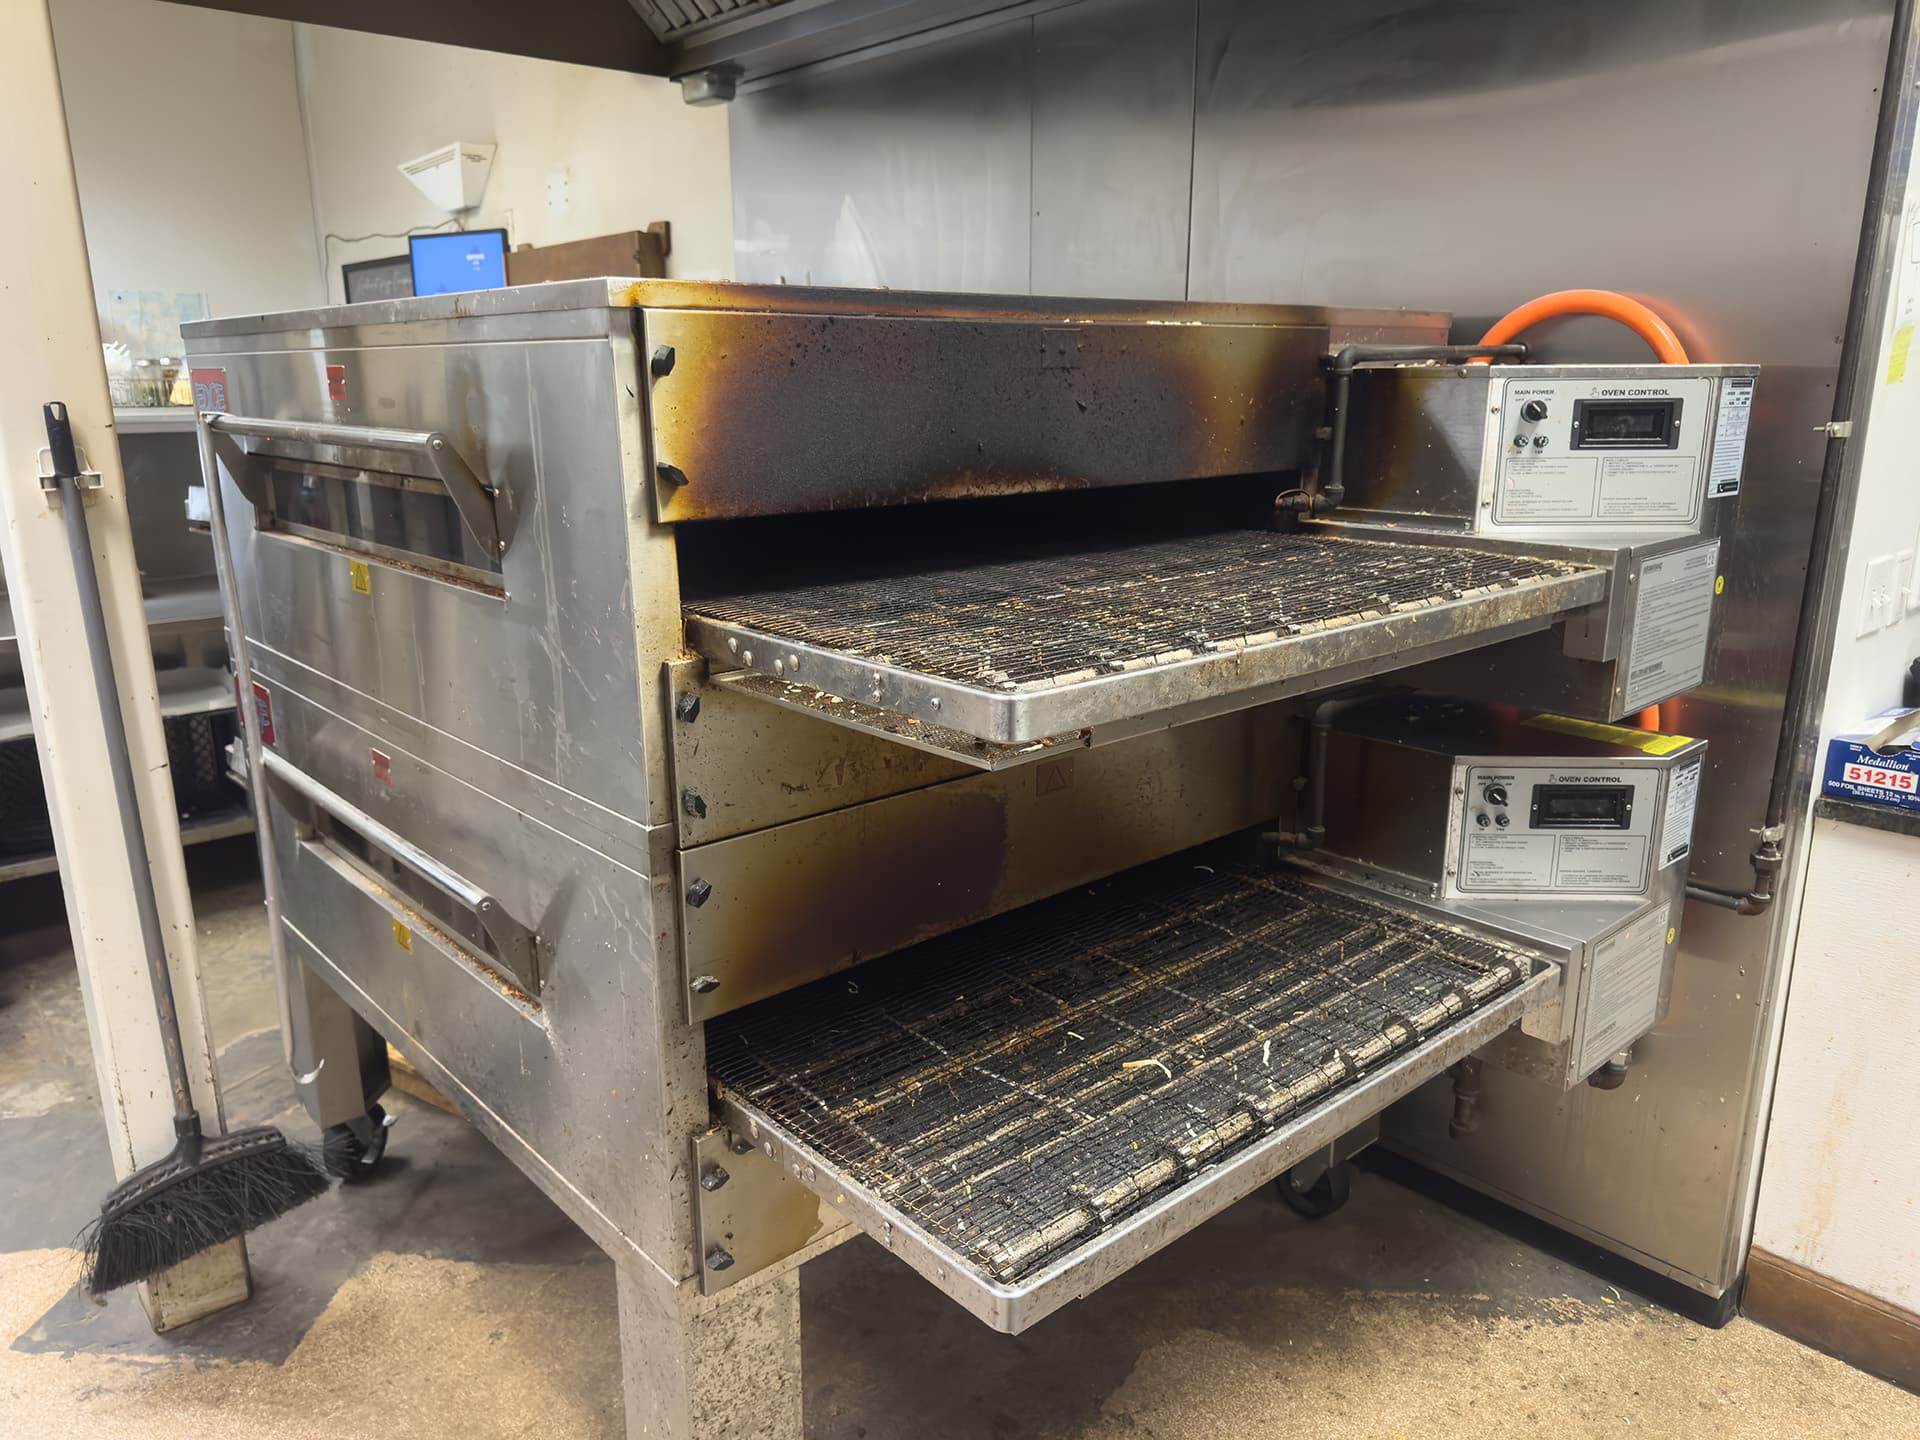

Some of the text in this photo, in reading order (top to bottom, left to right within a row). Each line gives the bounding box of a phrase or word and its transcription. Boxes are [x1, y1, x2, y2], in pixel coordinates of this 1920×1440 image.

[1628, 388, 1670, 396] CONTROL
[1856, 755, 1910, 771] Medallion
[1848, 767, 1912, 790] 51215
[1828, 780, 1840, 788] 500
[1857, 785, 1885, 796] SHEETS
